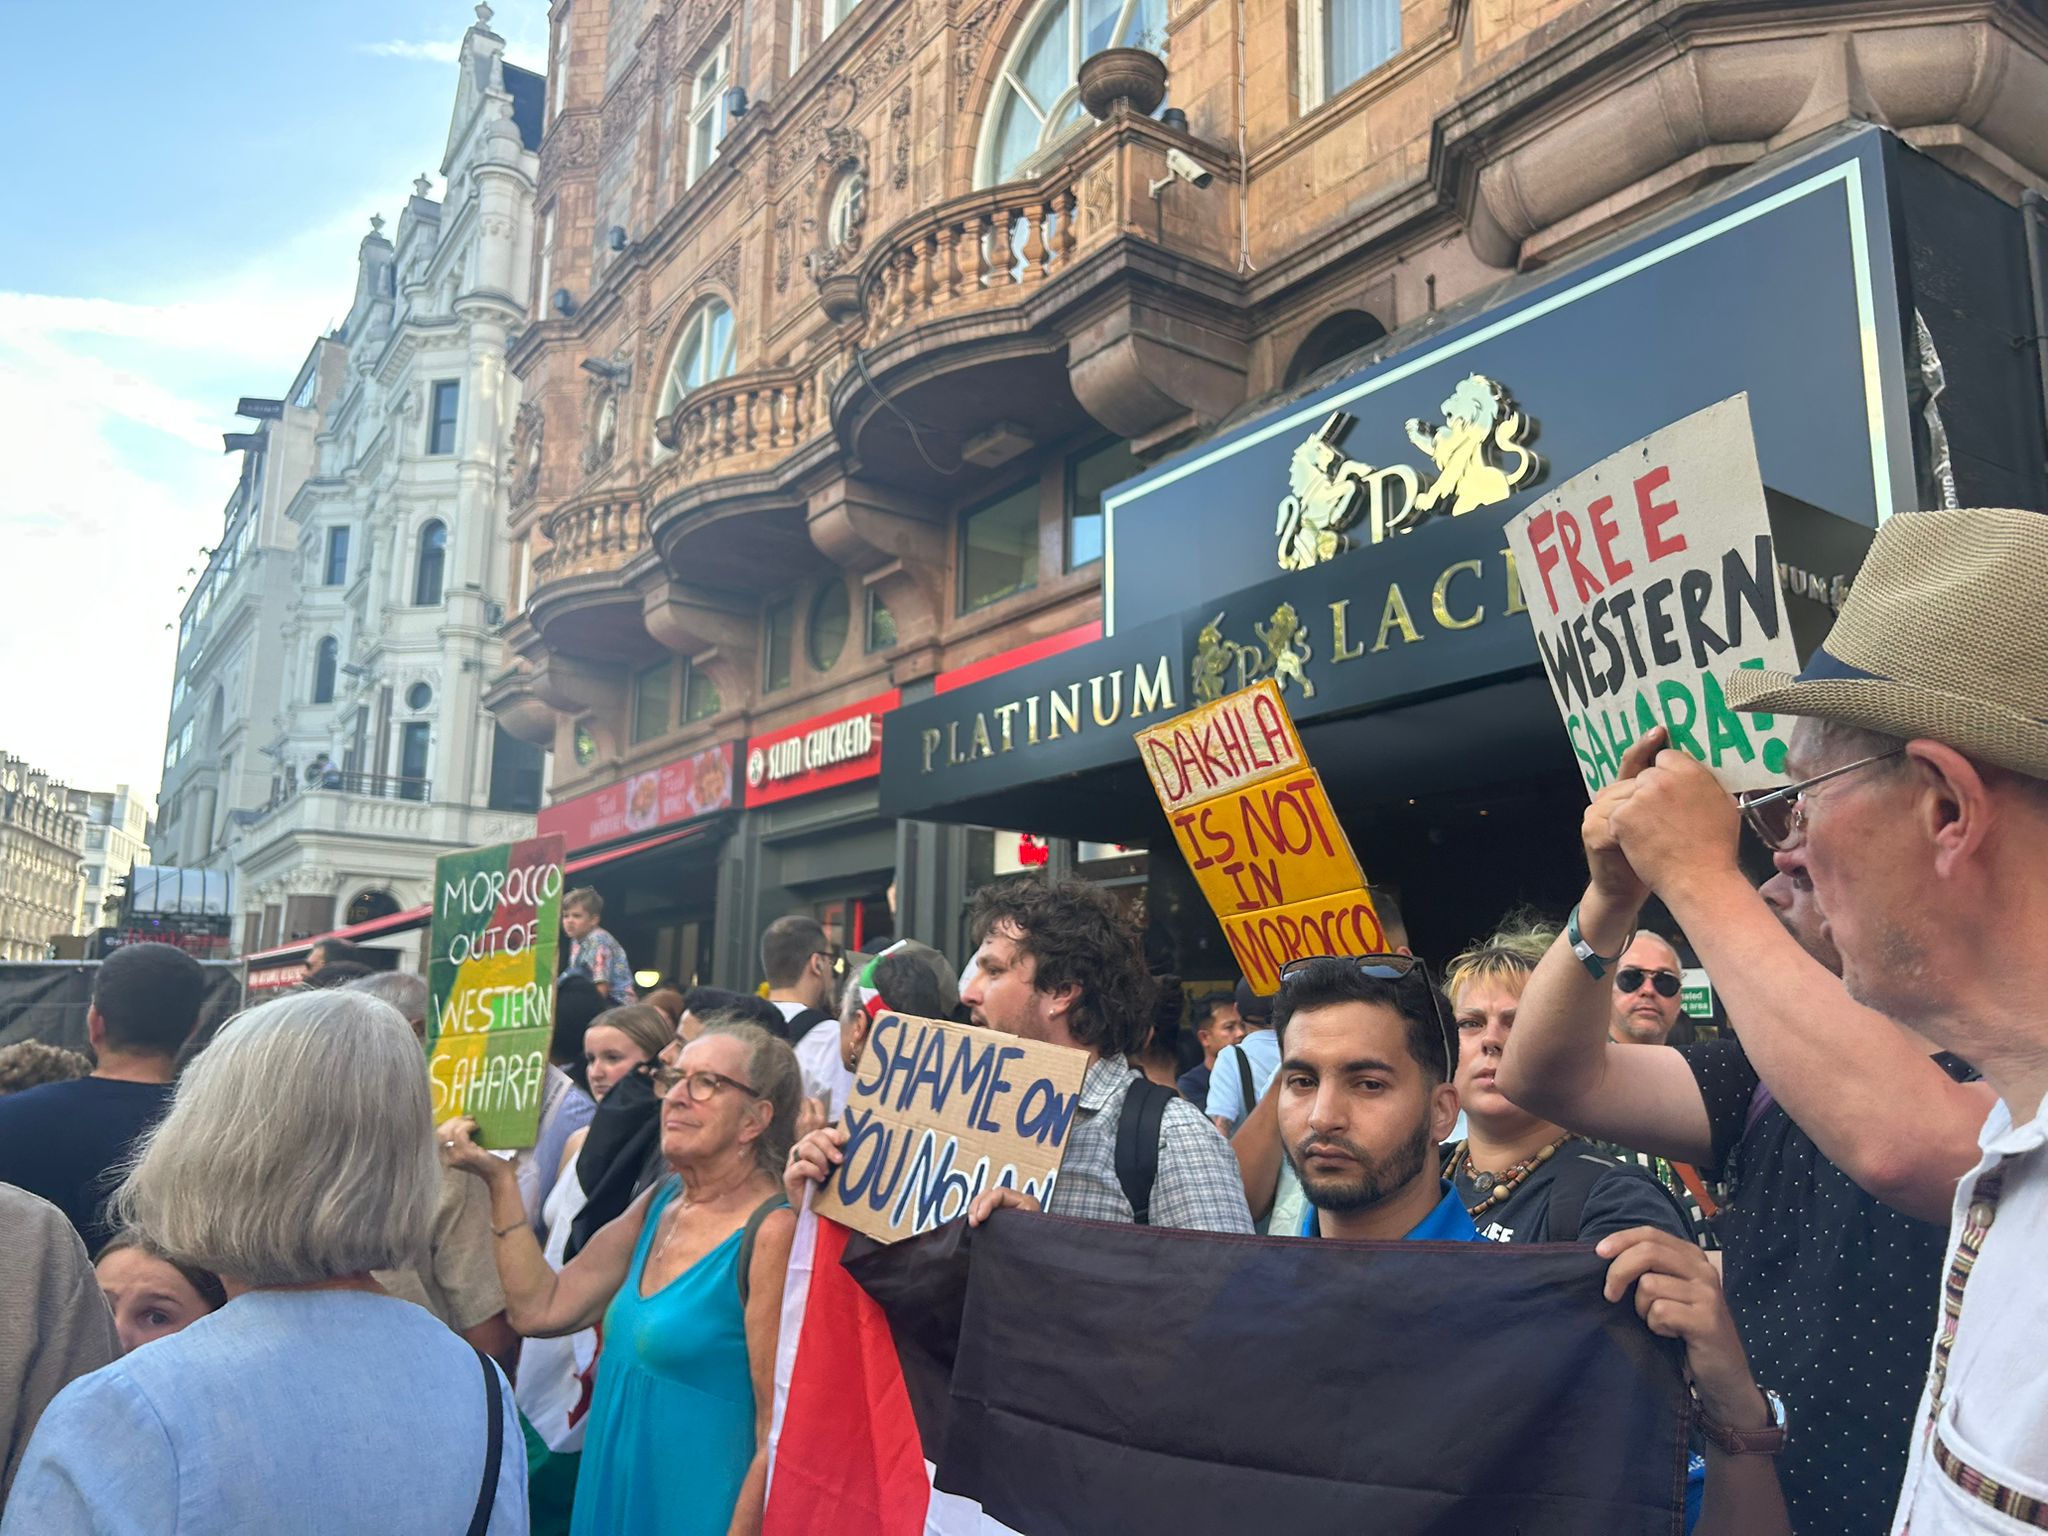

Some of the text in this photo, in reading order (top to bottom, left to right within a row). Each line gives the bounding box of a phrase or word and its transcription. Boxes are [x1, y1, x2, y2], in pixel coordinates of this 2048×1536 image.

[1527, 466, 1687, 615] FREE
[1539, 535, 1779, 711] WESTERN
[768, 713, 872, 780] SLIM CHICKENS
[921, 656, 1177, 774] PLATINUM
[1147, 694, 1293, 801] DAKHLA
[1174, 778, 1335, 870] IS NOT
[443, 863, 561, 919] MOROCCO
[1222, 858, 1283, 910] IN
[450, 919, 539, 965] OUT OF
[1225, 904, 1384, 988] MOROCCO
[434, 981, 552, 1034] WESTERN
[429, 1051, 543, 1113] SAHARA
[857, 1015, 1081, 1147] SHAME ON
[819, 1105, 912, 1212] YOU
